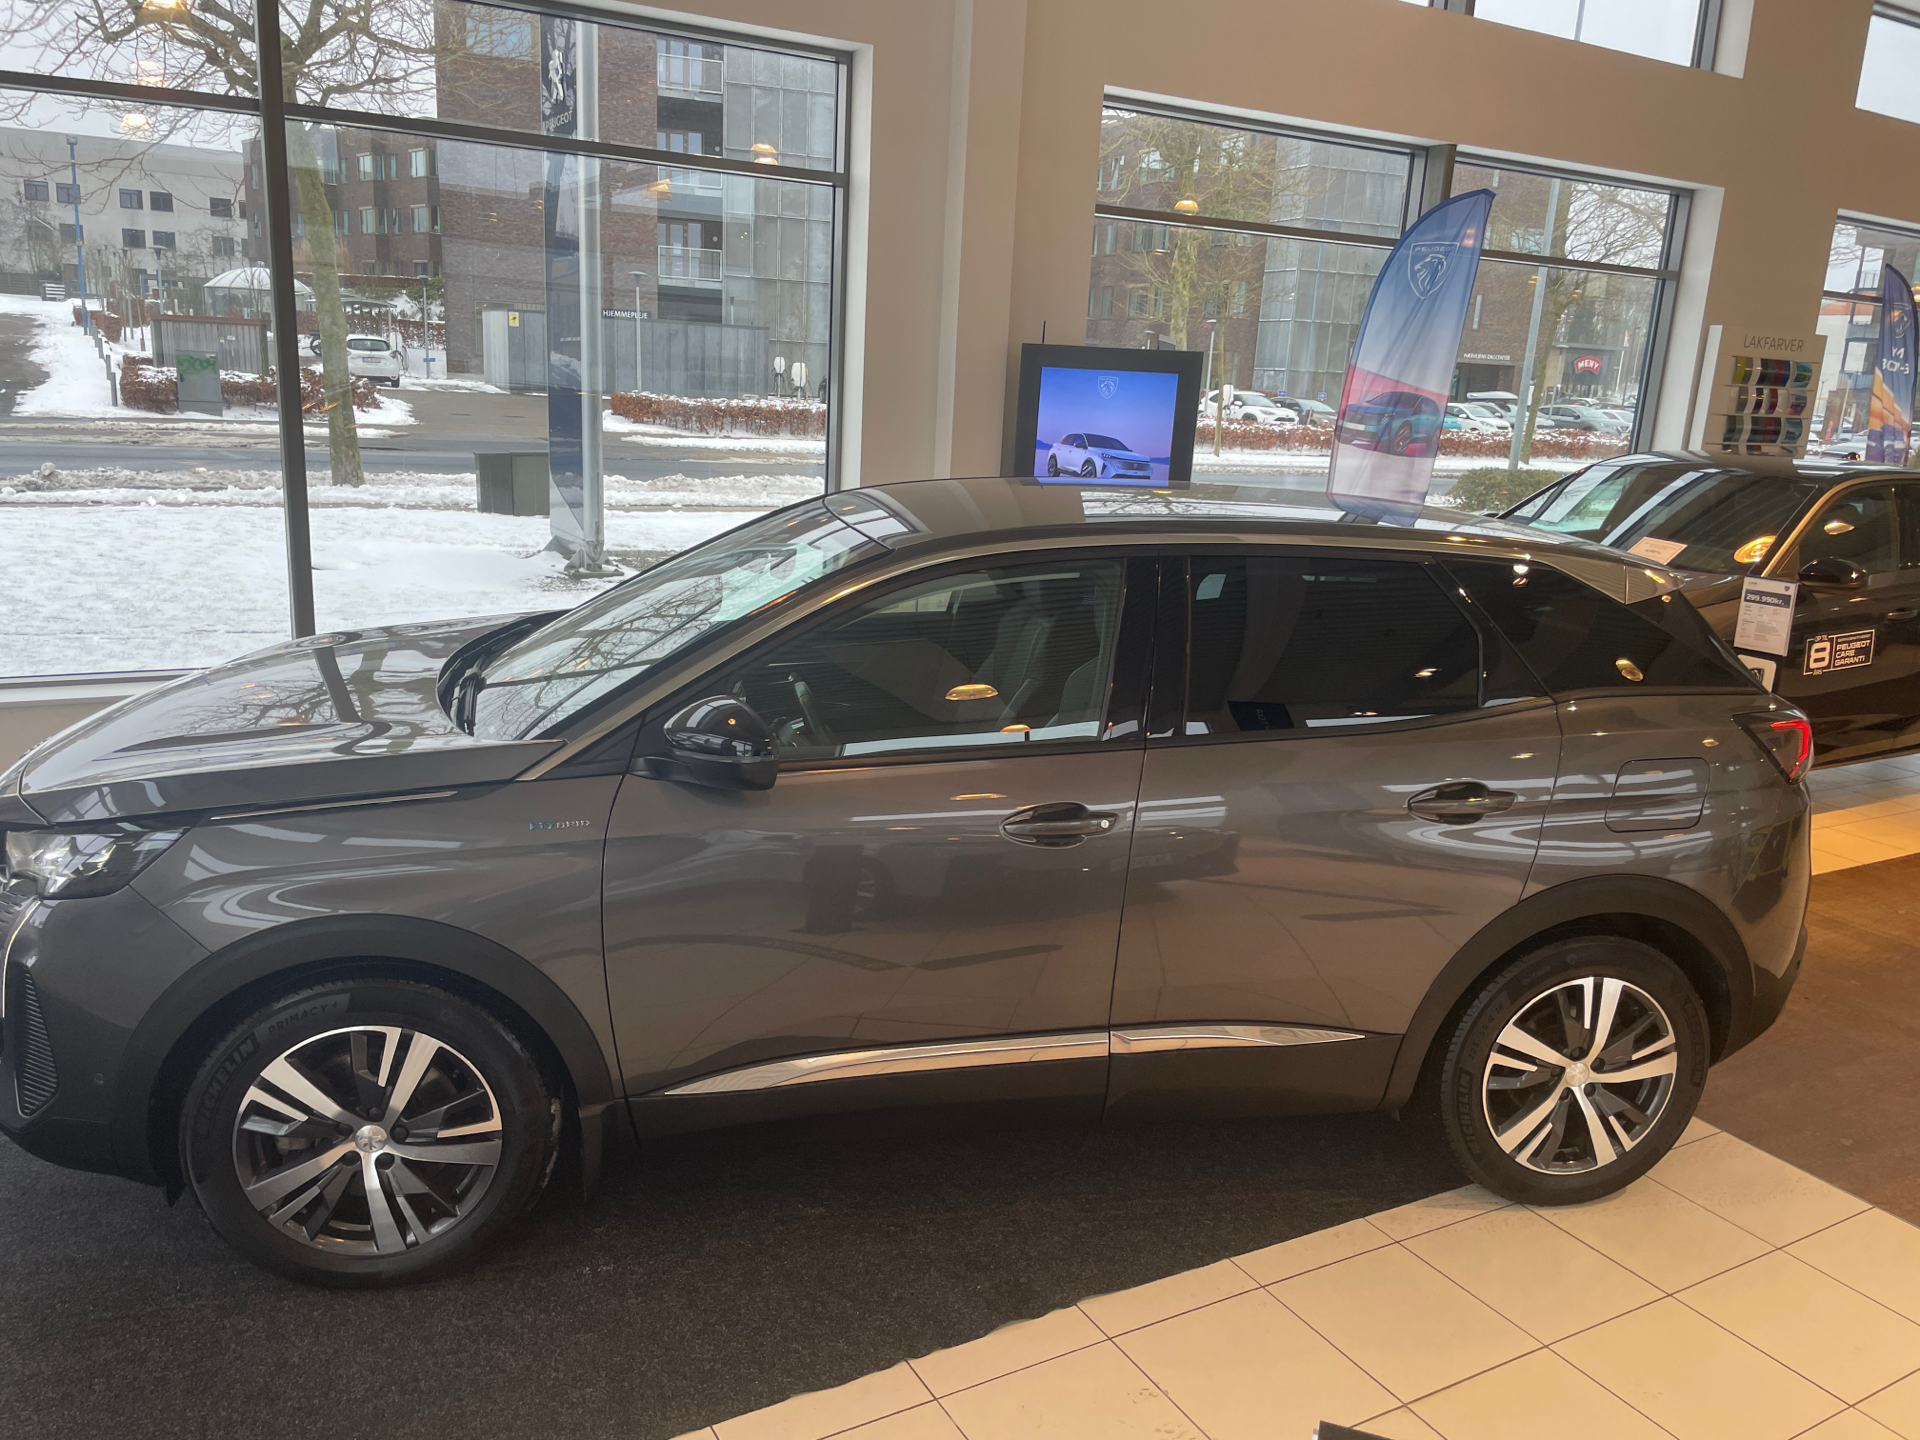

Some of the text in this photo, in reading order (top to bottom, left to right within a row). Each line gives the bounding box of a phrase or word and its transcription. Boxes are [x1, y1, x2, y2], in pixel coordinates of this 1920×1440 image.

[546, 111, 572, 130] PEUGEOT
[1743, 334, 1804, 352] LAKFARVER
[1578, 359, 1599, 370] MENY
[1836, 640, 1871, 651] PEUGEOT
[1809, 641, 1831, 669] 8
[1835, 650, 1856, 659] CARE
[1835, 655, 1866, 666] GARANTI
[529, 820, 591, 831] HYBRID
[268, 1003, 329, 1036] PRIMACY
